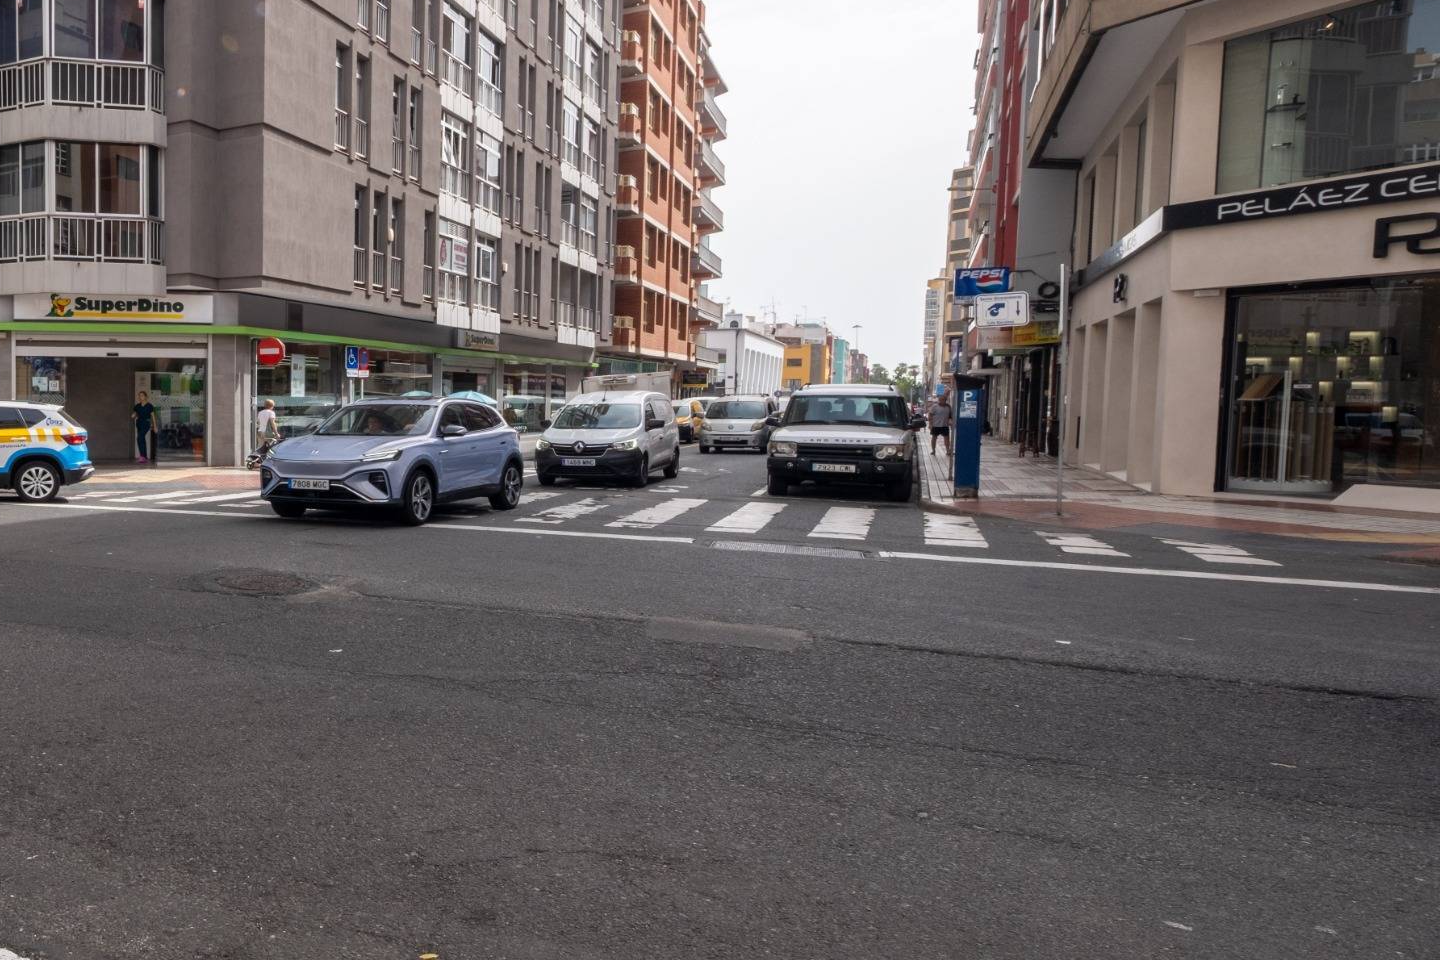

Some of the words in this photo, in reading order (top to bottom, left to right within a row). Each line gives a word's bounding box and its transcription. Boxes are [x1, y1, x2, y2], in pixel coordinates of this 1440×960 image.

[1217, 183, 1371, 220] PELÁEZ
[1380, 174, 1440, 198] CE
[960, 268, 1005, 280] PEPSI
[74, 296, 185, 314] SuperDino
[963, 390, 974, 402] P
